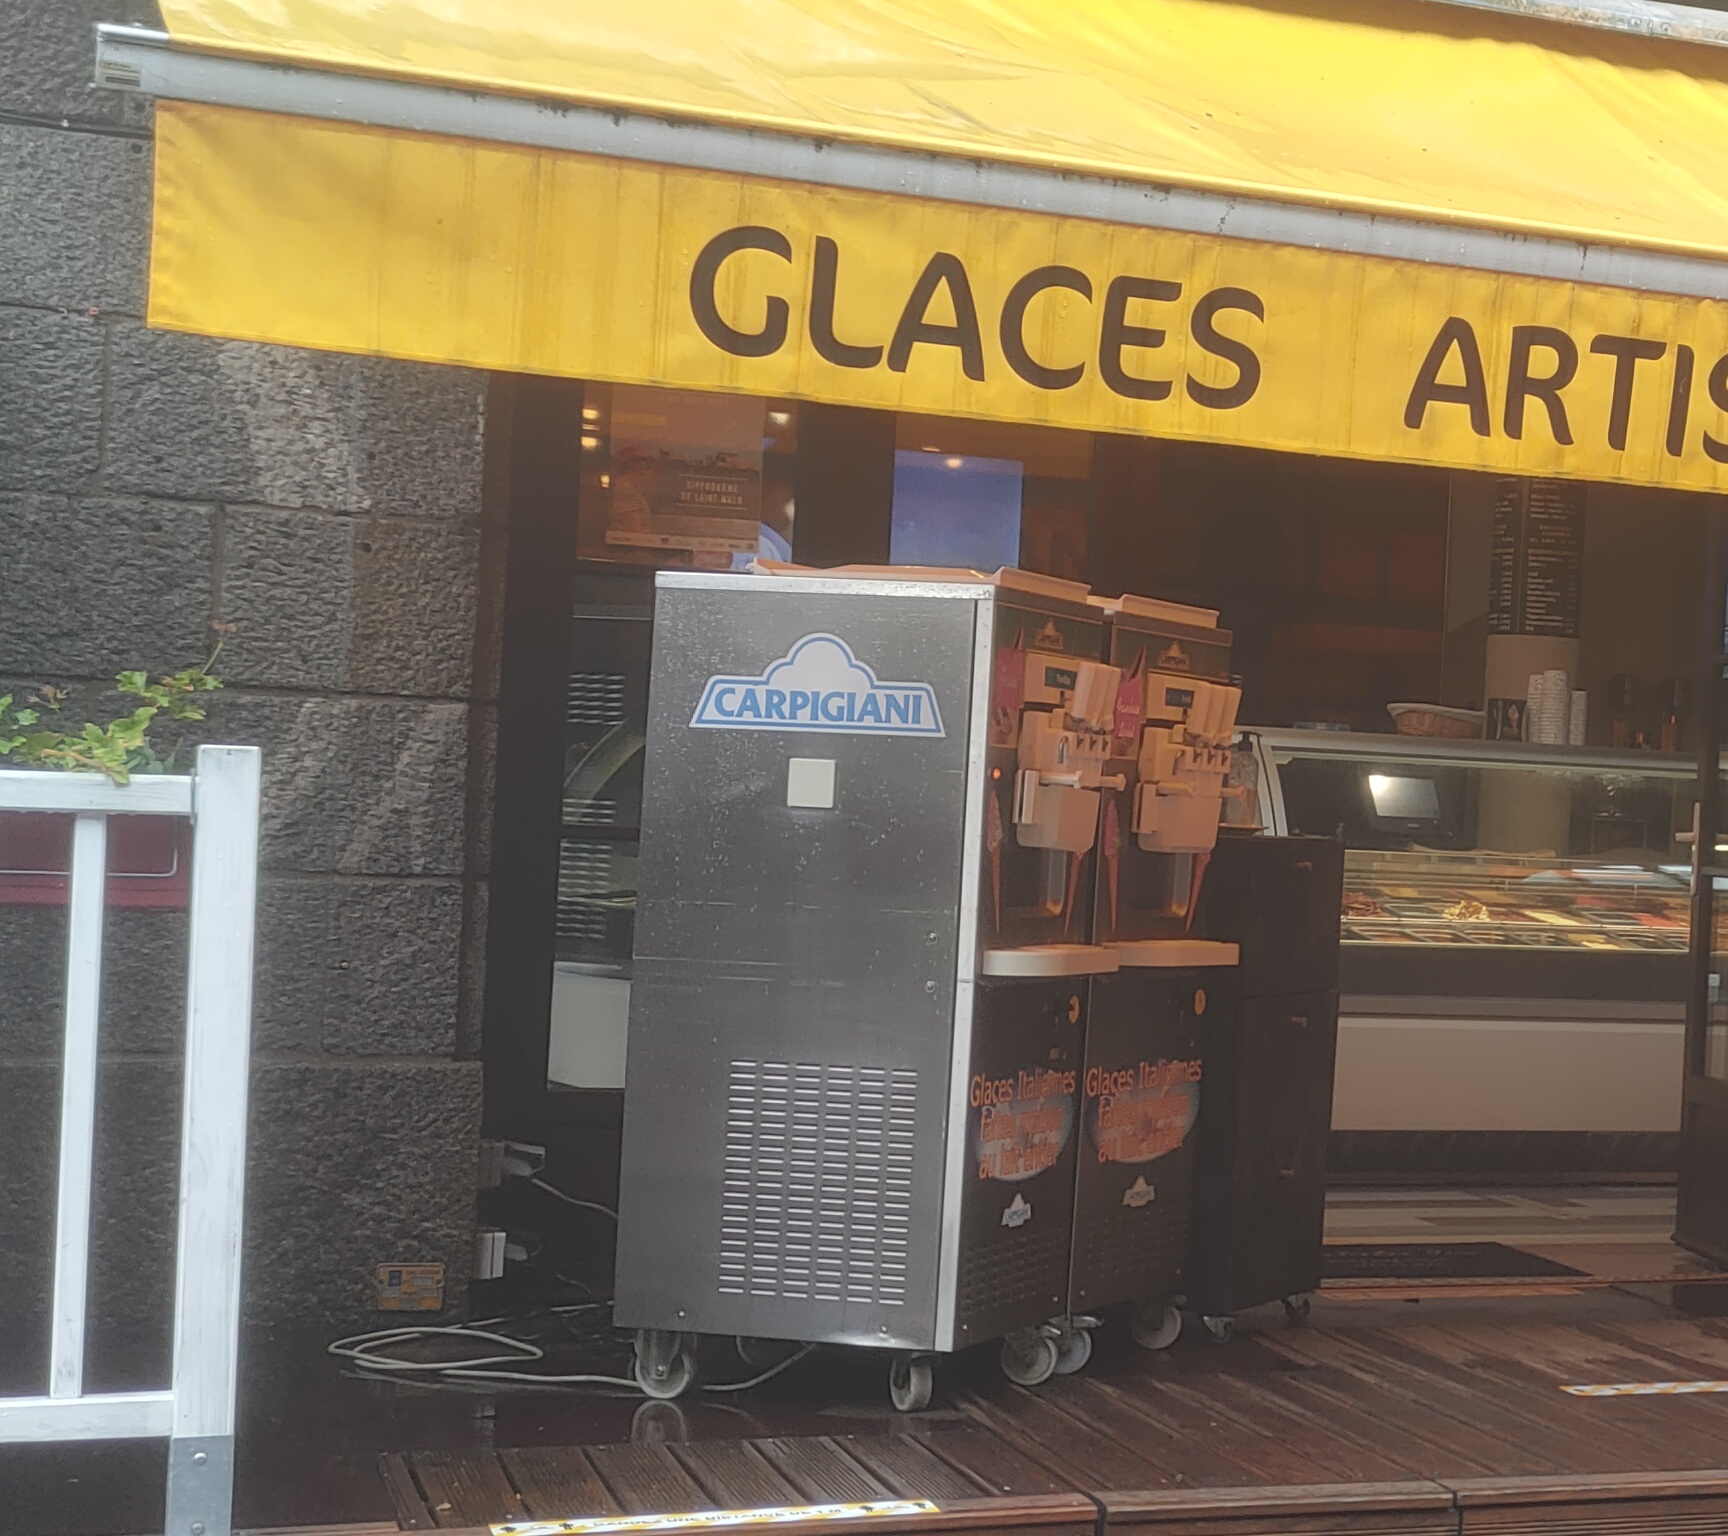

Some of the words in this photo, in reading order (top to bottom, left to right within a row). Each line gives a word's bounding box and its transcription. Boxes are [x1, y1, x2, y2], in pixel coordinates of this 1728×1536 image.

[689, 225, 1265, 410] GLACES
[713, 686, 923, 726] CARPIGIANI
[970, 1073, 1014, 1109] Glaces
[1085, 1065, 1135, 1098] Glaces
